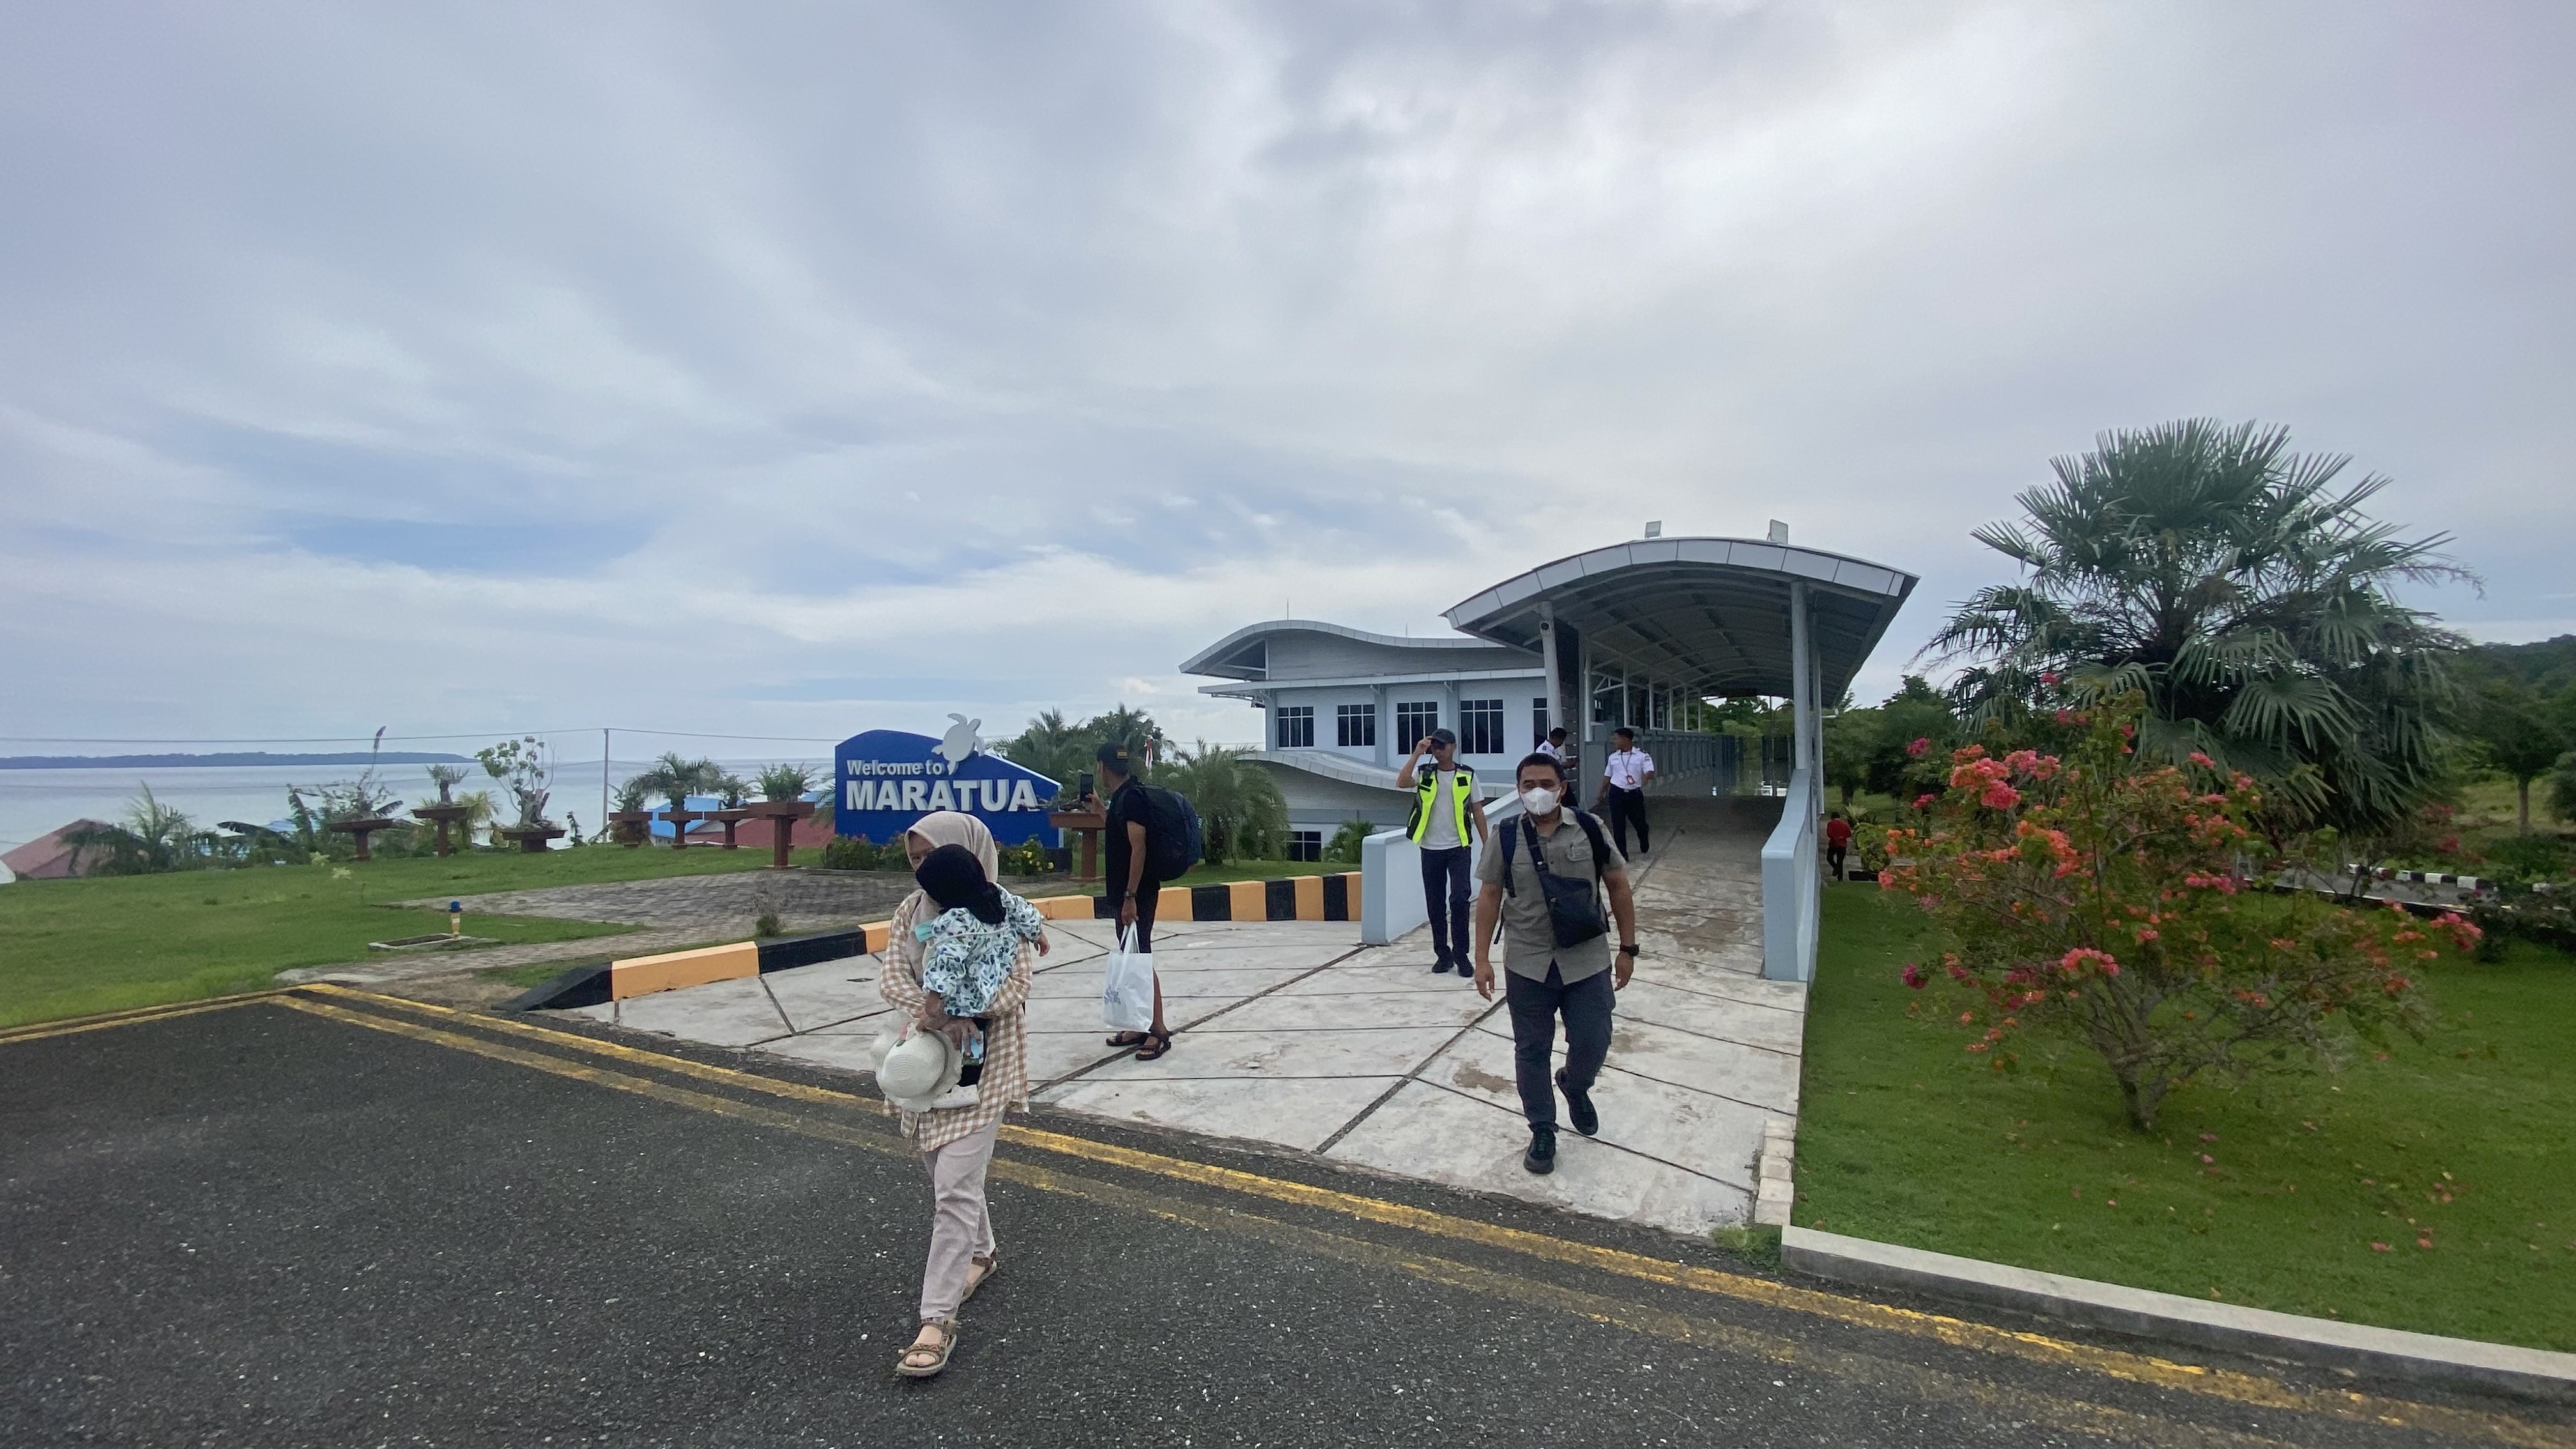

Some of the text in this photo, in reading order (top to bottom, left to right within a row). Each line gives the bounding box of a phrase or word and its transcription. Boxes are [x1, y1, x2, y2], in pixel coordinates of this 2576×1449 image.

[847, 759, 944, 776] Welcome to
[846, 779, 1041, 812] MARATUA
